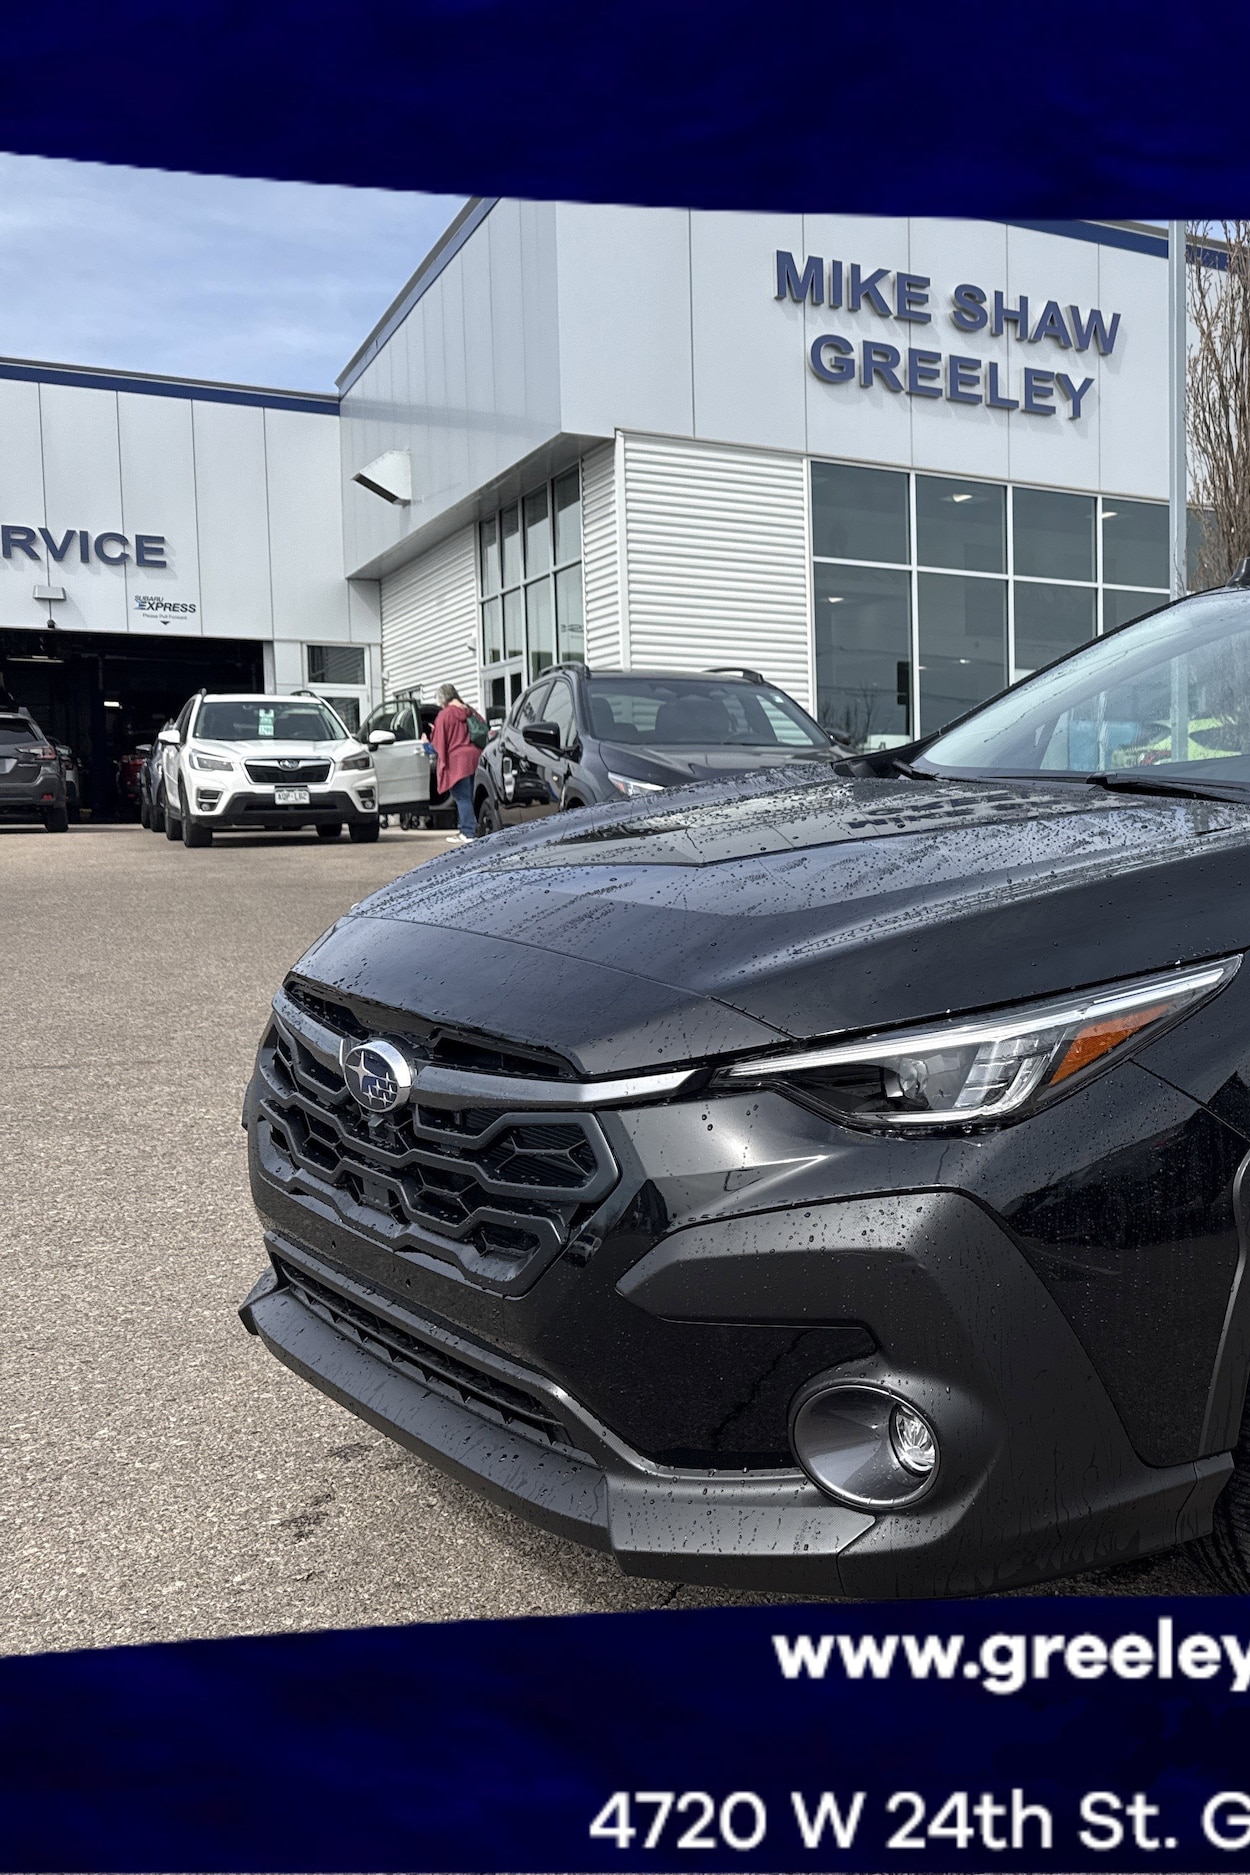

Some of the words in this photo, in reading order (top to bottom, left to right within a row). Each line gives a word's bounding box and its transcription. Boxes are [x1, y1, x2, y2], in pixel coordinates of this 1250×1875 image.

[775, 249, 932, 324] MIKE
[949, 283, 1122, 355] SHAW
[809, 334, 1094, 420] GREELEY
[1, 524, 167, 568] RVICE
[134, 600, 197, 613] EXPRESS
